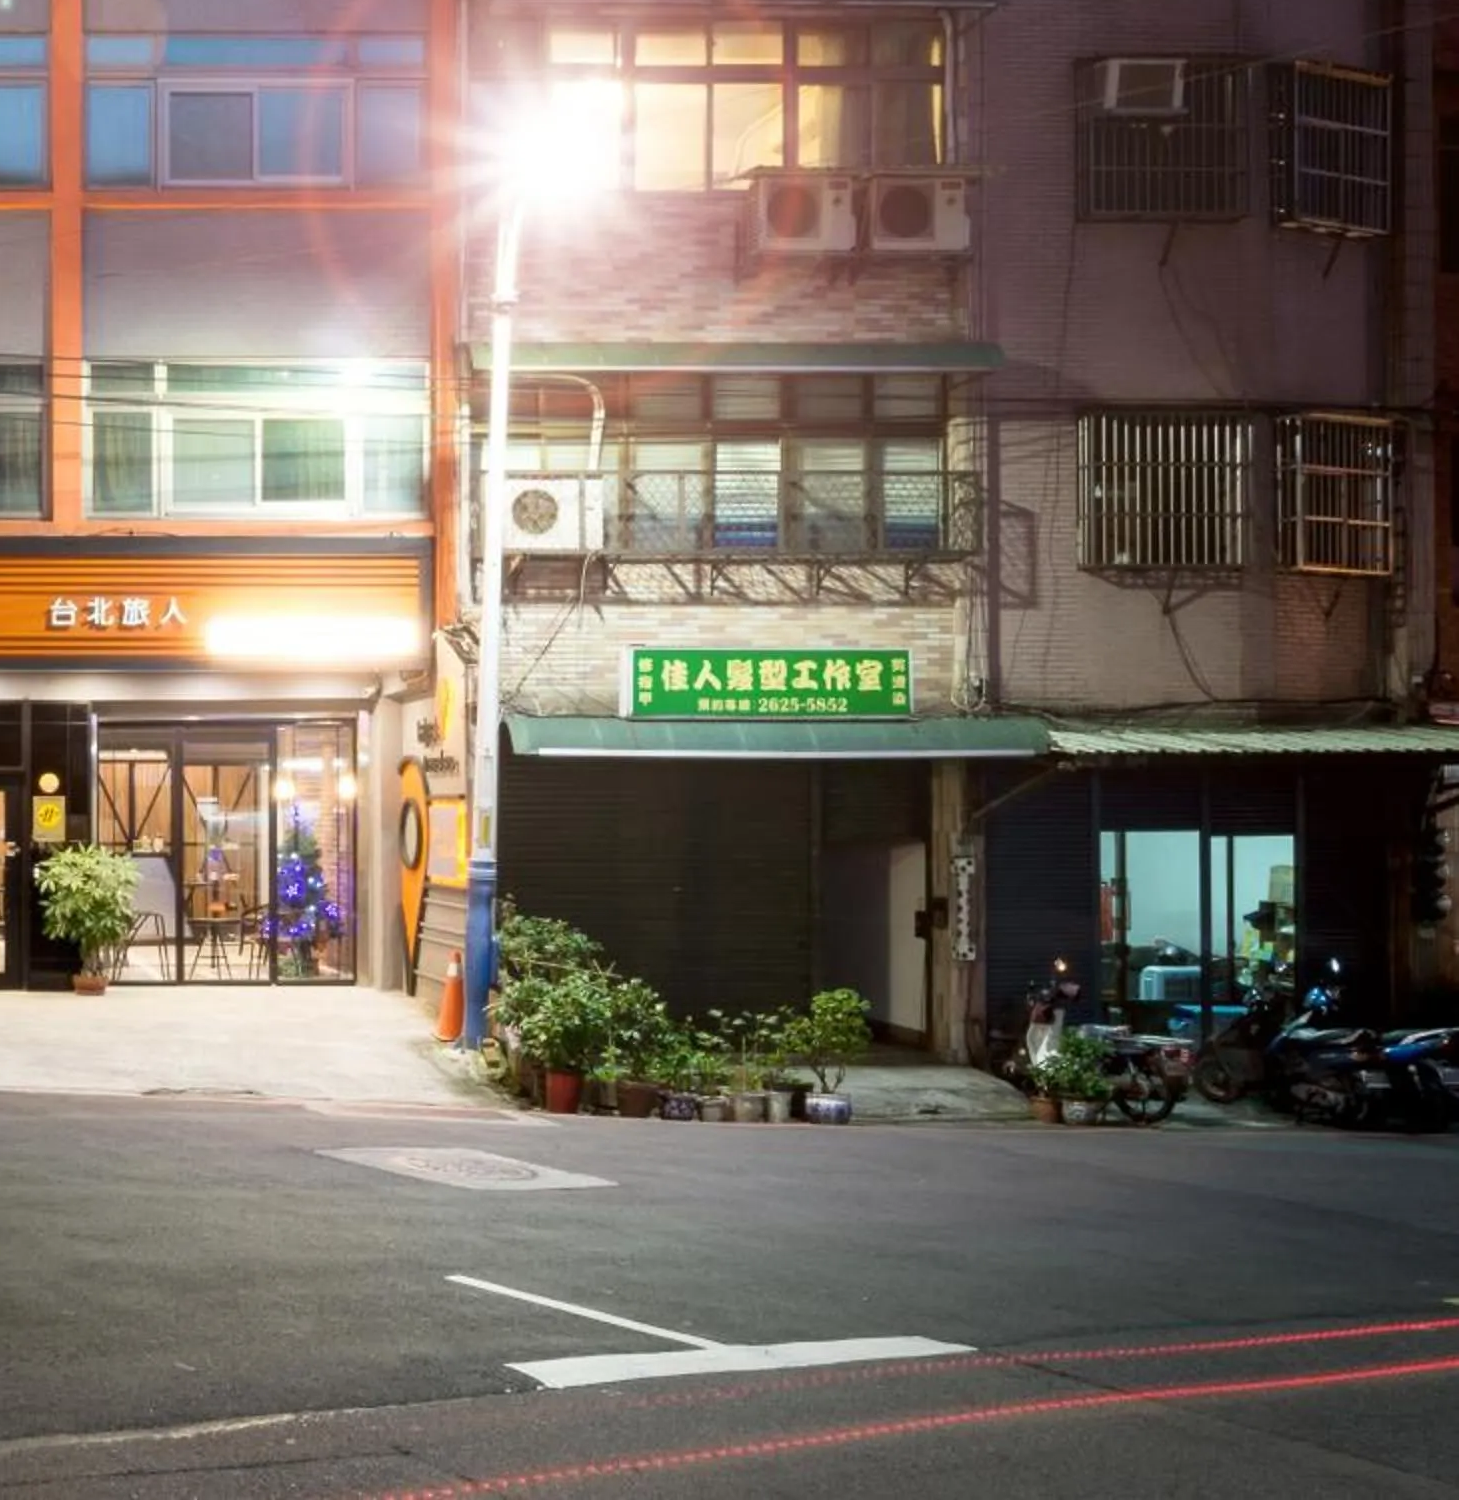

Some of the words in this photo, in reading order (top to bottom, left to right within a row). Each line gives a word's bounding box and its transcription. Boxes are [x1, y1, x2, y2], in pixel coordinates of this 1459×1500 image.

[49, 596, 188, 627] 台北旅人
[758, 697, 848, 713] 2625-5852
